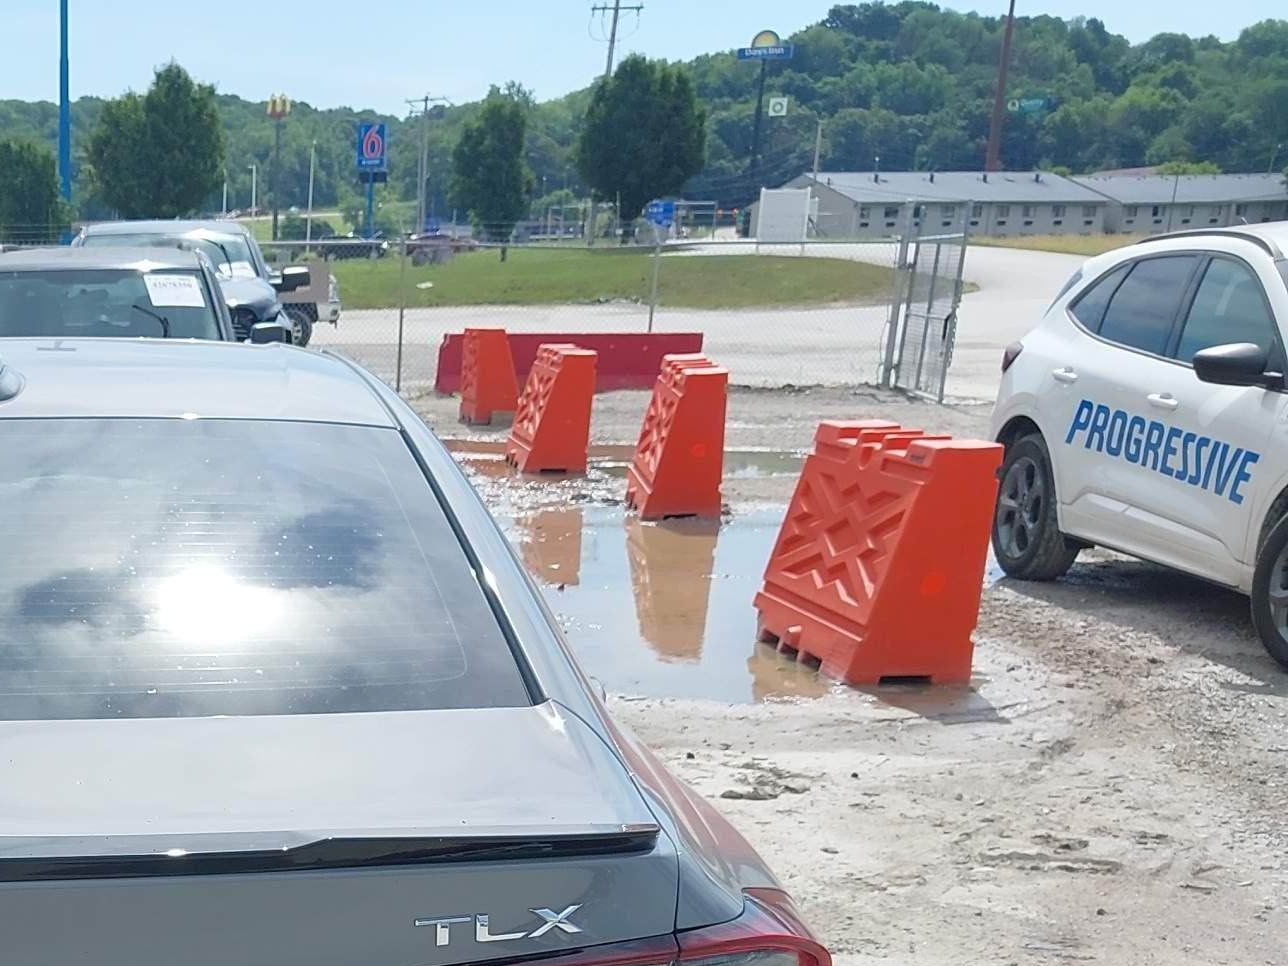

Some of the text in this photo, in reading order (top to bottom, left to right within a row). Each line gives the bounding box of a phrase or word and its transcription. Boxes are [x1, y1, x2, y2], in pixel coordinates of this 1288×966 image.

[362, 125, 383, 160] 6
[1065, 399, 1260, 505] PROGRESSIVE
[414, 903, 584, 946] TLX
